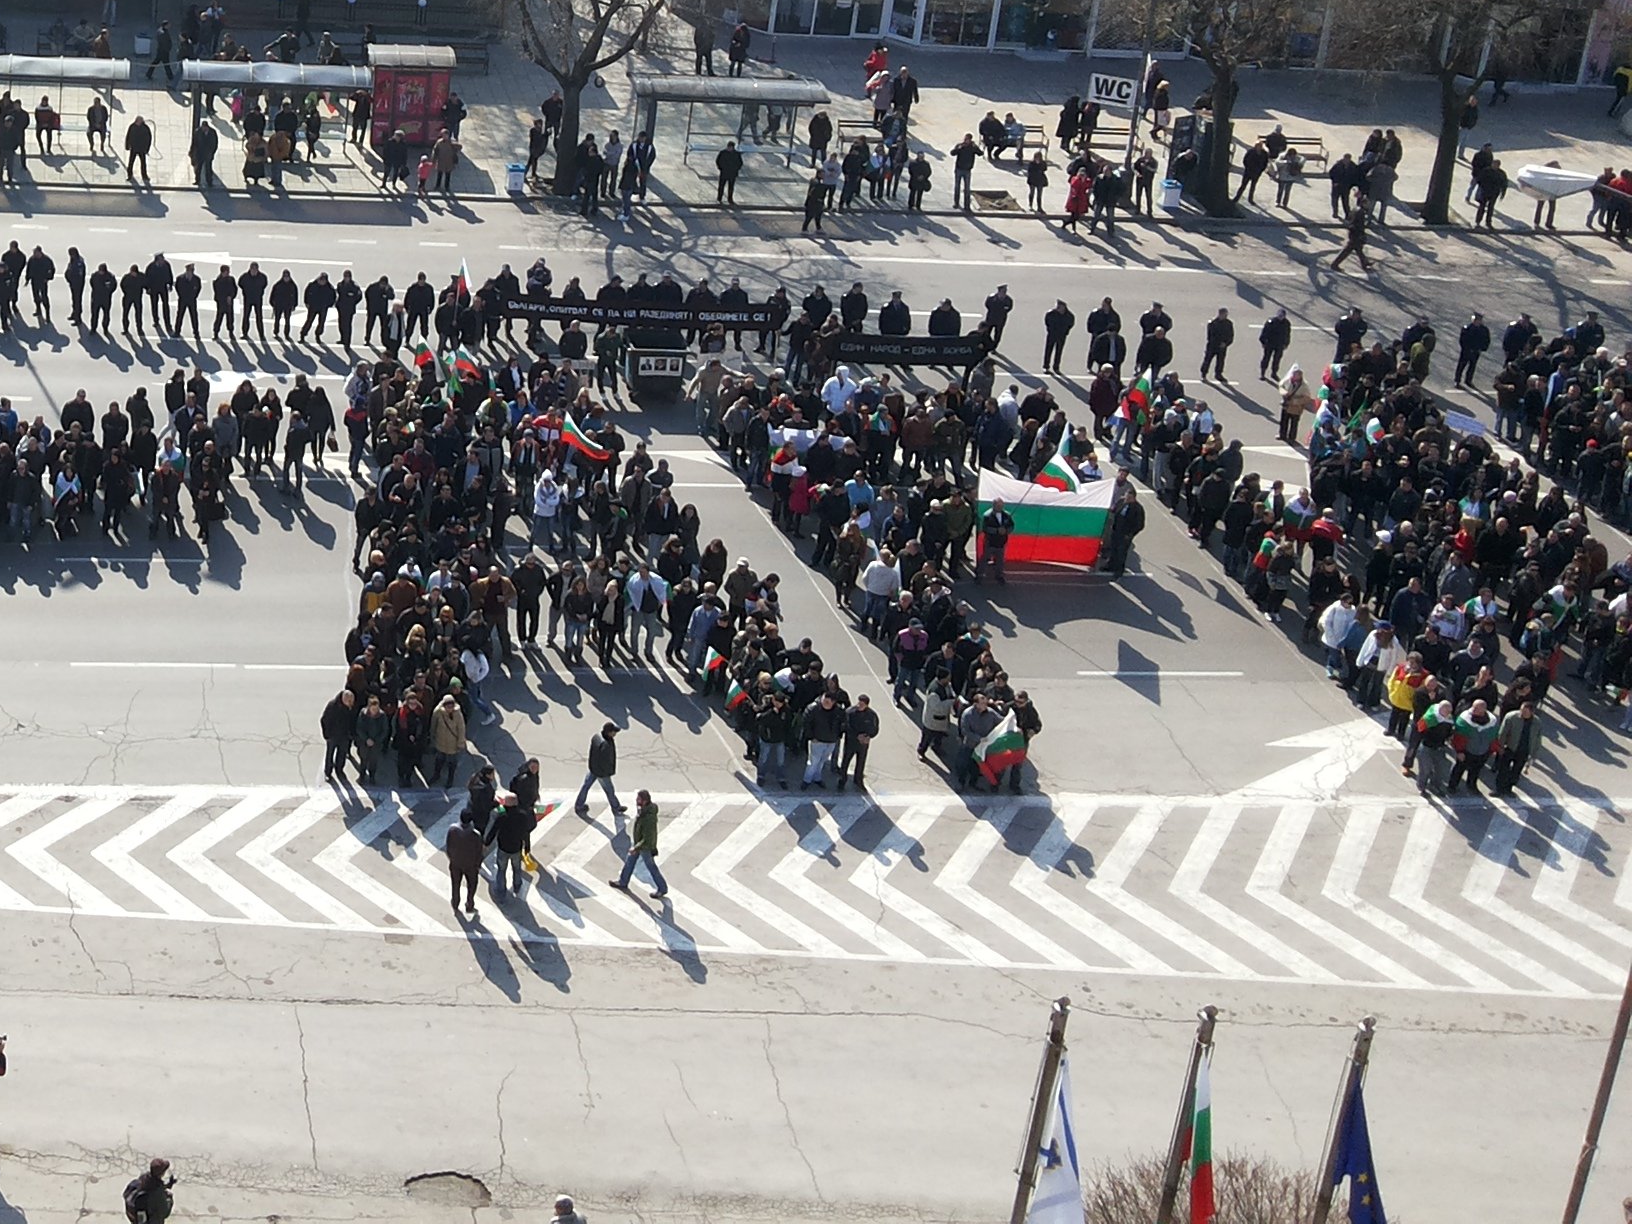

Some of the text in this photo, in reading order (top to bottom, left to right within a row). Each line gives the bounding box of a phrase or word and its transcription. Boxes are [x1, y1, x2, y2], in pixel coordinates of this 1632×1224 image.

[1095, 76, 1132, 100] WC
[840, 342, 865, 352] ЕДИН
[870, 344, 901, 355] НАРОД
[912, 346, 936, 355] ЕДНА
